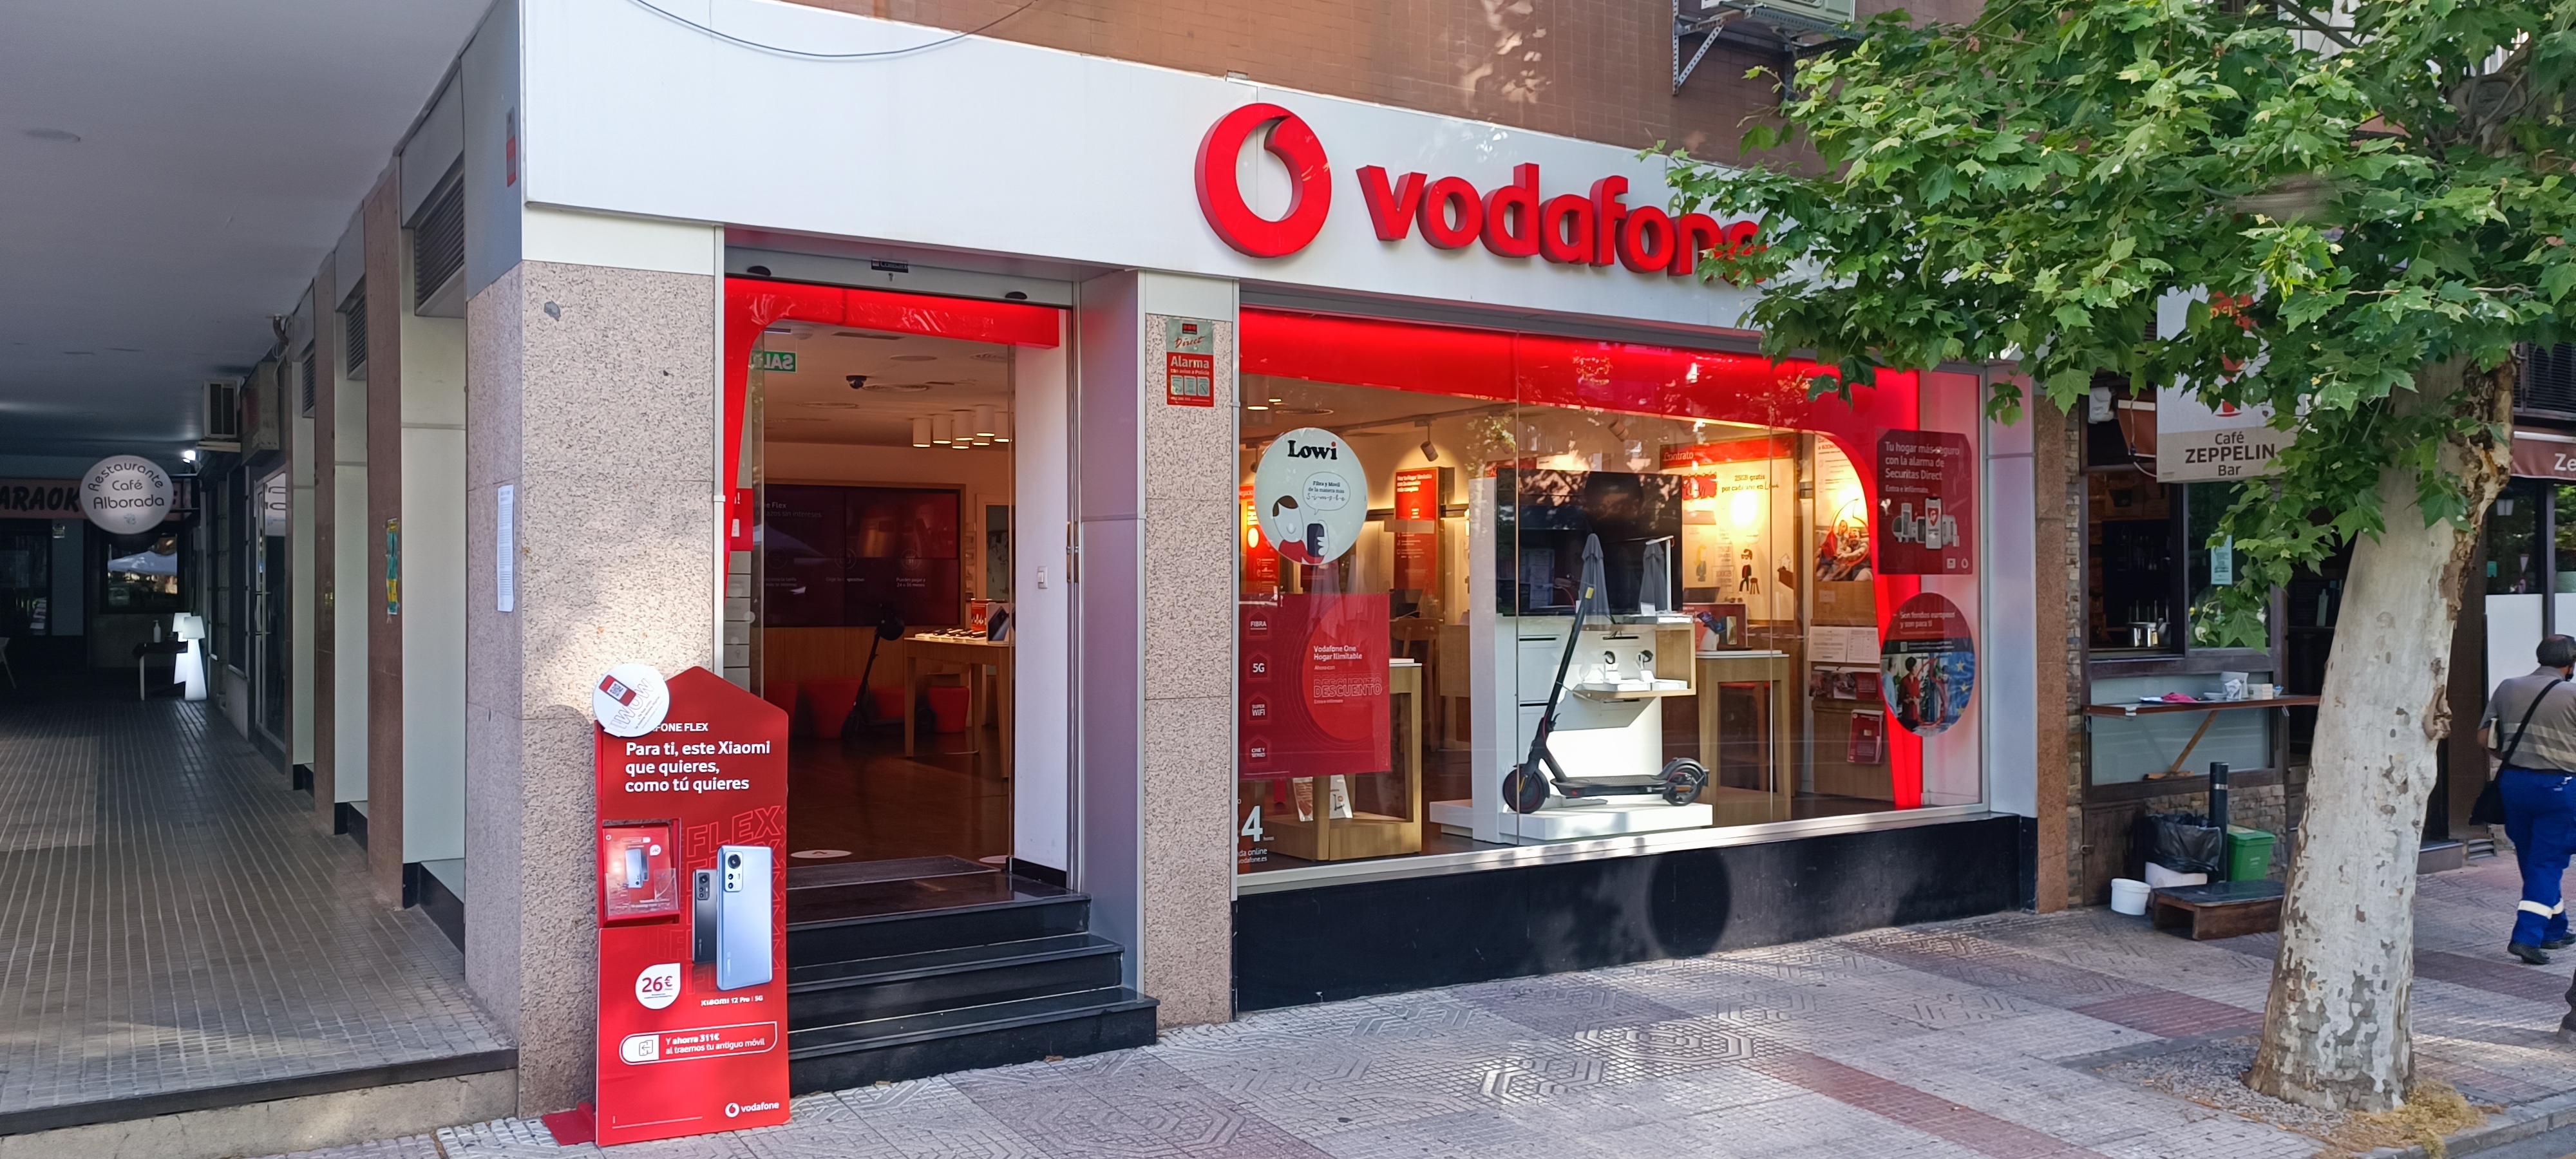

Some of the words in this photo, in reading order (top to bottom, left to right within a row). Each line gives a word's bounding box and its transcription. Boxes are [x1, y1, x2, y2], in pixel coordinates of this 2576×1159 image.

[1171, 355, 1209, 369] Alarma
[2215, 431, 2244, 446] Café
[1287, 440, 1338, 460] Lowi
[1885, 441, 1894, 451] Tu
[1895, 442, 1917, 455] hogar
[1918, 444, 1932, 453] más
[2185, 444, 2275, 464] ZEPPELIN
[1663, 452, 1694, 462] Contrato
[1900, 455, 1908, 465] la
[1909, 457, 1934, 467] alarma
[1935, 458, 1944, 467] de
[88, 462, 164, 492] Restaurante
[1885, 468, 1919, 479] Securitas
[1920, 470, 1943, 480] Direct
[2218, 464, 2241, 476] Bar
[112, 480, 143, 491] Café
[0, 485, 80, 513] ARAOK
[93, 495, 164, 509] Alborada
[1314, 653, 1332, 661] Hogar
[1253, 663, 1265, 672] 5G
[1314, 683, 1382, 698] DESCUENTO
[684, 722, 709, 732] FLEX
[626, 742, 660, 756] Para
[663, 742, 679, 757] ti,
[682, 742, 715, 755] este
[718, 740, 770, 755] Xiaomi
[625, 762, 655, 777] que
[658, 760, 720, 777] quieres,
[625, 781, 669, 792] como
[672, 777, 689, 791] tú
[692, 777, 750, 794] quieres
[1248, 847, 1267, 856] online
[642, 975, 673, 993] 26€
[672, 1035, 698, 1044] ahorra
[699, 1033, 720, 1042] 311€
[715, 1041, 743, 1050] antiguo
[744, 1037, 765, 1048] móvil
[741, 1102, 779, 1113] vodafone
